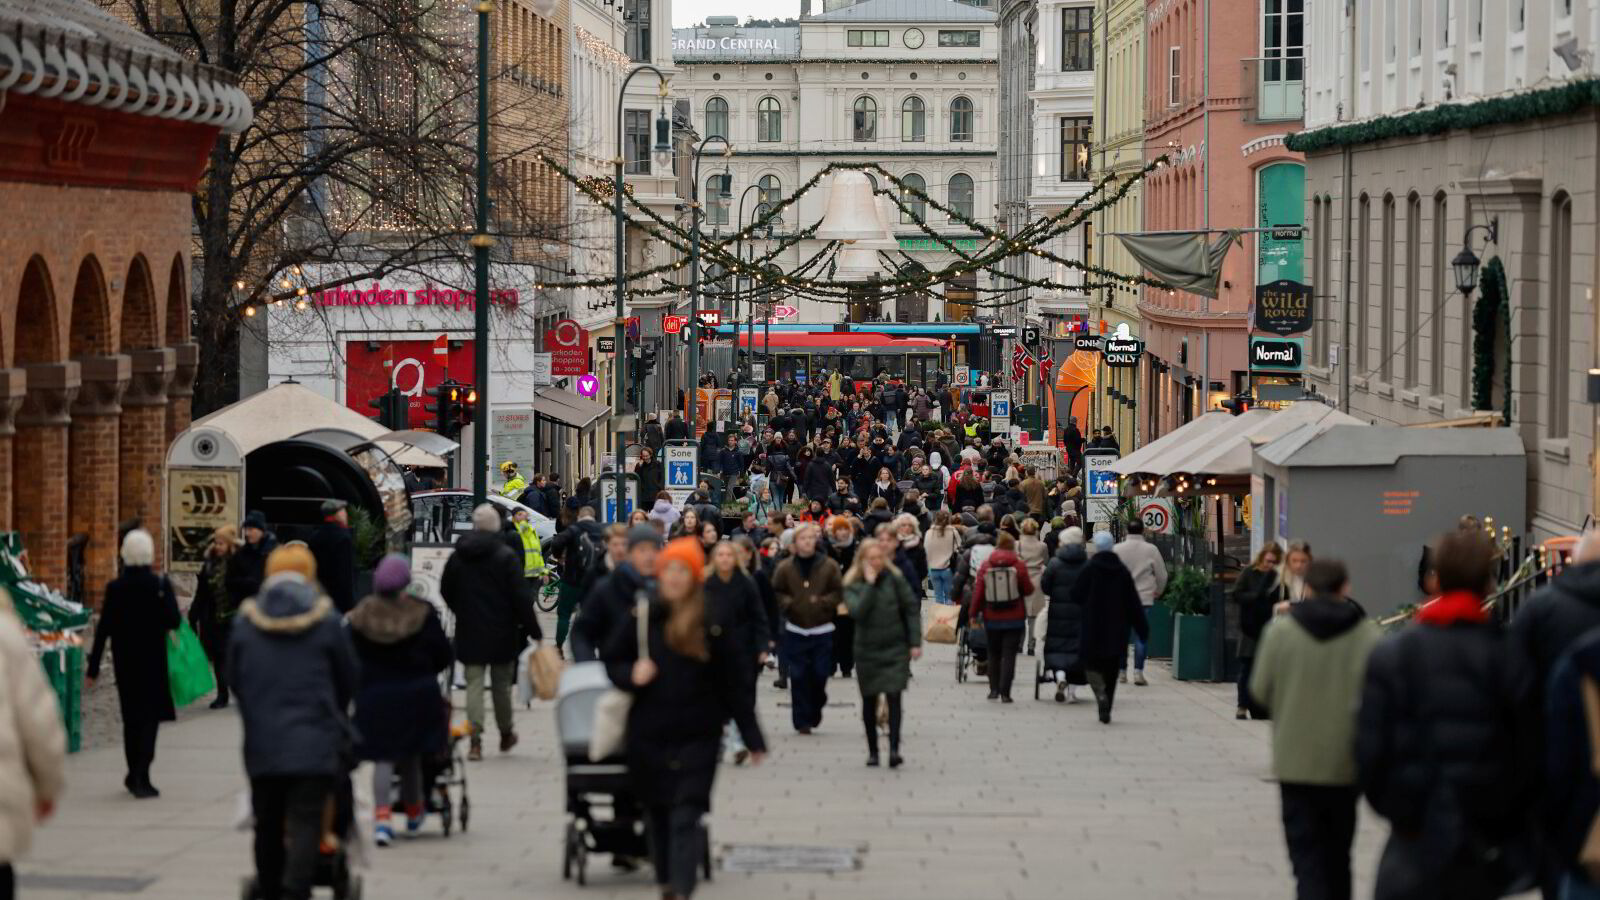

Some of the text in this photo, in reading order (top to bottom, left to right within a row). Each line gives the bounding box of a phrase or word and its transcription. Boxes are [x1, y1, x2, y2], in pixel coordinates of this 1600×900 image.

[720, 37, 779, 50] CENTRAL
[667, 318, 678, 330] deli
[1108, 342, 1137, 352] Normal
[1256, 345, 1293, 361] Normal
[1107, 354, 1136, 363] ONLY
[671, 449, 692, 457] Sone
[1091, 458, 1112, 466] Sone
[607, 484, 631, 494] Se
[1144, 512, 1164, 526] 30
